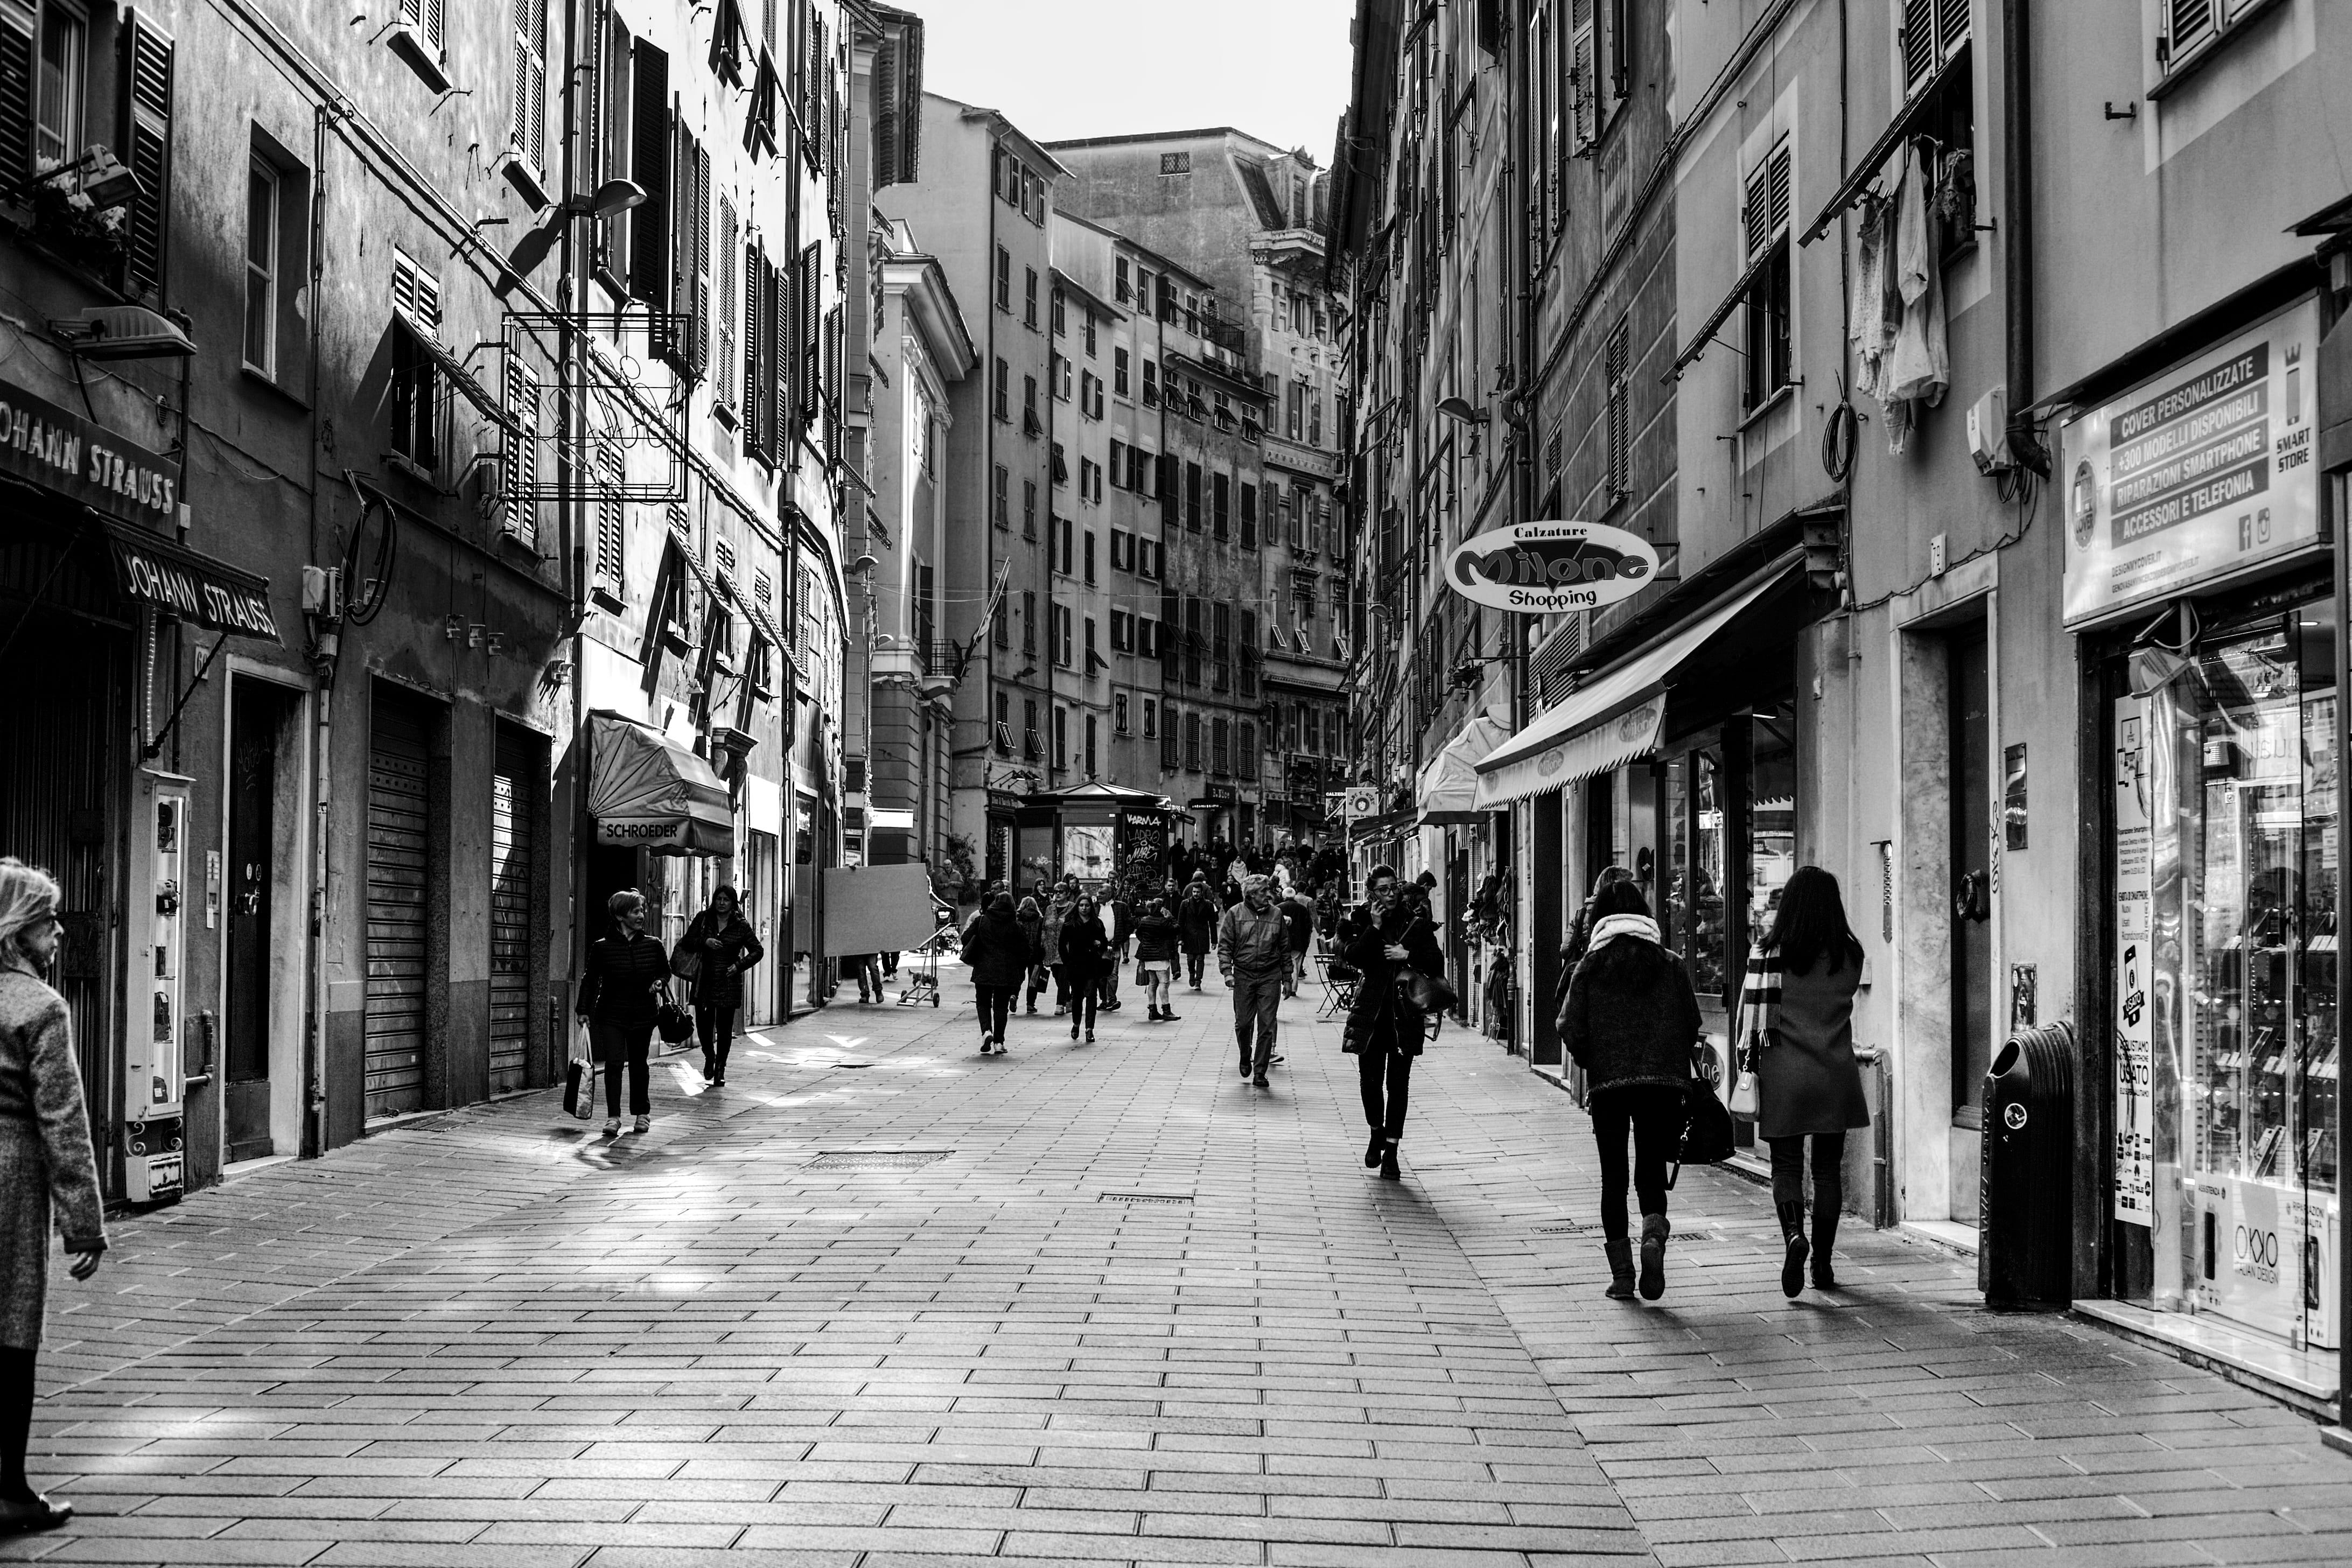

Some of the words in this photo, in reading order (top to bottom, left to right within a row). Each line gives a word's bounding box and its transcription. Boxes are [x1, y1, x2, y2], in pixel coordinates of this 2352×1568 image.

[2122, 405, 2155, 438] COVER
[2157, 355, 2253, 421] PERSONALIZZATE
[2119, 448, 2141, 472] +300
[2144, 424, 2188, 465] MODELLI
[2191, 391, 2258, 442] DISPONIBILI
[2277, 427, 2311, 454] SMART
[2117, 463, 2181, 508] RIPARAZIONI
[2183, 428, 2260, 480] SMARTPHONE
[2278, 447, 2309, 473] STORE
[89, 445, 173, 514] STRAUSS
[2123, 499, 2180, 540] ACCESSORI
[2182, 495, 2189, 517] E
[2192, 470, 2255, 513] TELEFONIA
[1514, 527, 1587, 538] Calzature
[1455, 549, 1648, 586] Milone
[1933, 545, 1940, 569] 79
[2112, 550, 2161, 577] DESIGNMYCOVER.IT
[126, 554, 199, 617] JOHANN
[204, 582, 276, 636] STRAUSS
[1509, 590, 1597, 610] Shopping
[1622, 716, 1655, 741] Milone
[1213, 788, 1230, 798] B.Nice
[606, 824, 677, 838] SCHROEDER
[2127, 992, 2141, 1011] USATO
[2120, 1063, 2148, 1085] USATO
[2198, 1185, 2220, 1195] ASSISTENZA
